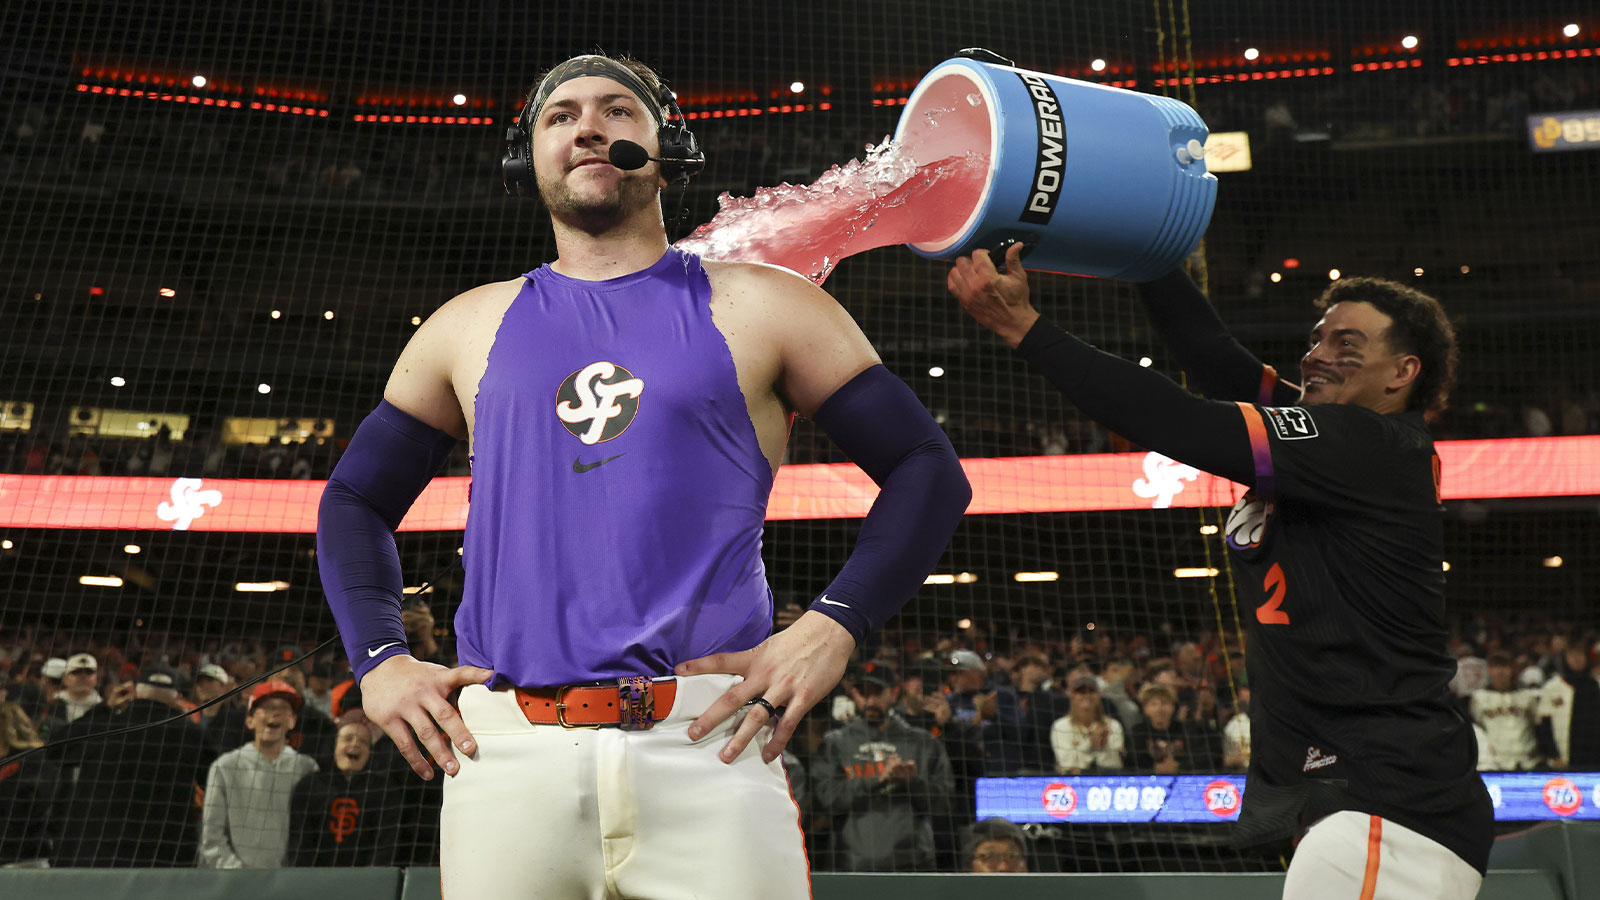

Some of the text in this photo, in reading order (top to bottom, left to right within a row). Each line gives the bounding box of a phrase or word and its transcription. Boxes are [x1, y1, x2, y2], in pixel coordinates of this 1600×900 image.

[1021, 73, 1063, 213] POWERAD
[556, 361, 645, 446] SF
[1256, 561, 1290, 625] 2
[1045, 786, 1074, 811] 76
[1206, 785, 1238, 810] 76
[1546, 780, 1579, 808] 76
[330, 798, 360, 843] SF
